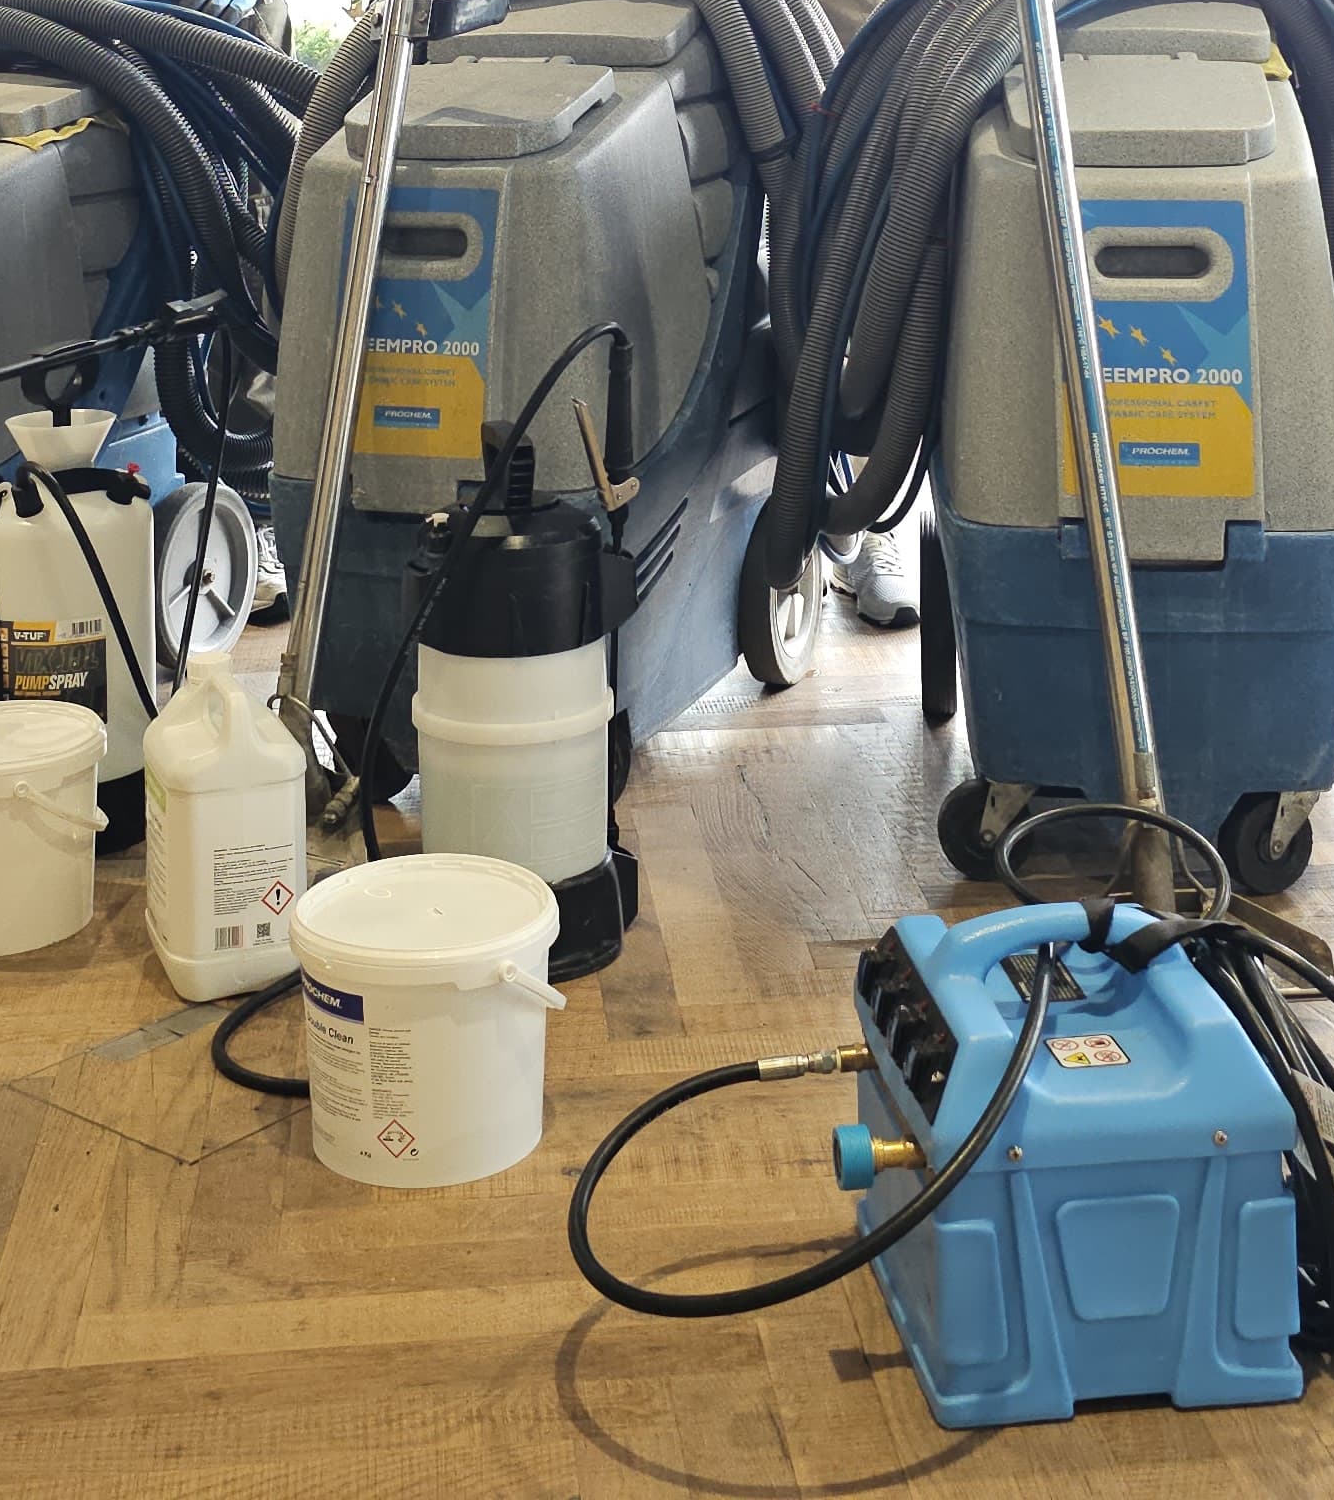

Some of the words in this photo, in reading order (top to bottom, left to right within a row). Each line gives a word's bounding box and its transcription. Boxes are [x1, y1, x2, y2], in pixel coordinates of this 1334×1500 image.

[442, 340, 480, 356] 2000
[1102, 367, 1191, 384] EEMPRO
[1196, 368, 1243, 385] 2000
[13, 631, 44, 641] V-TUF
[328, 1027, 354, 1045] Clean
